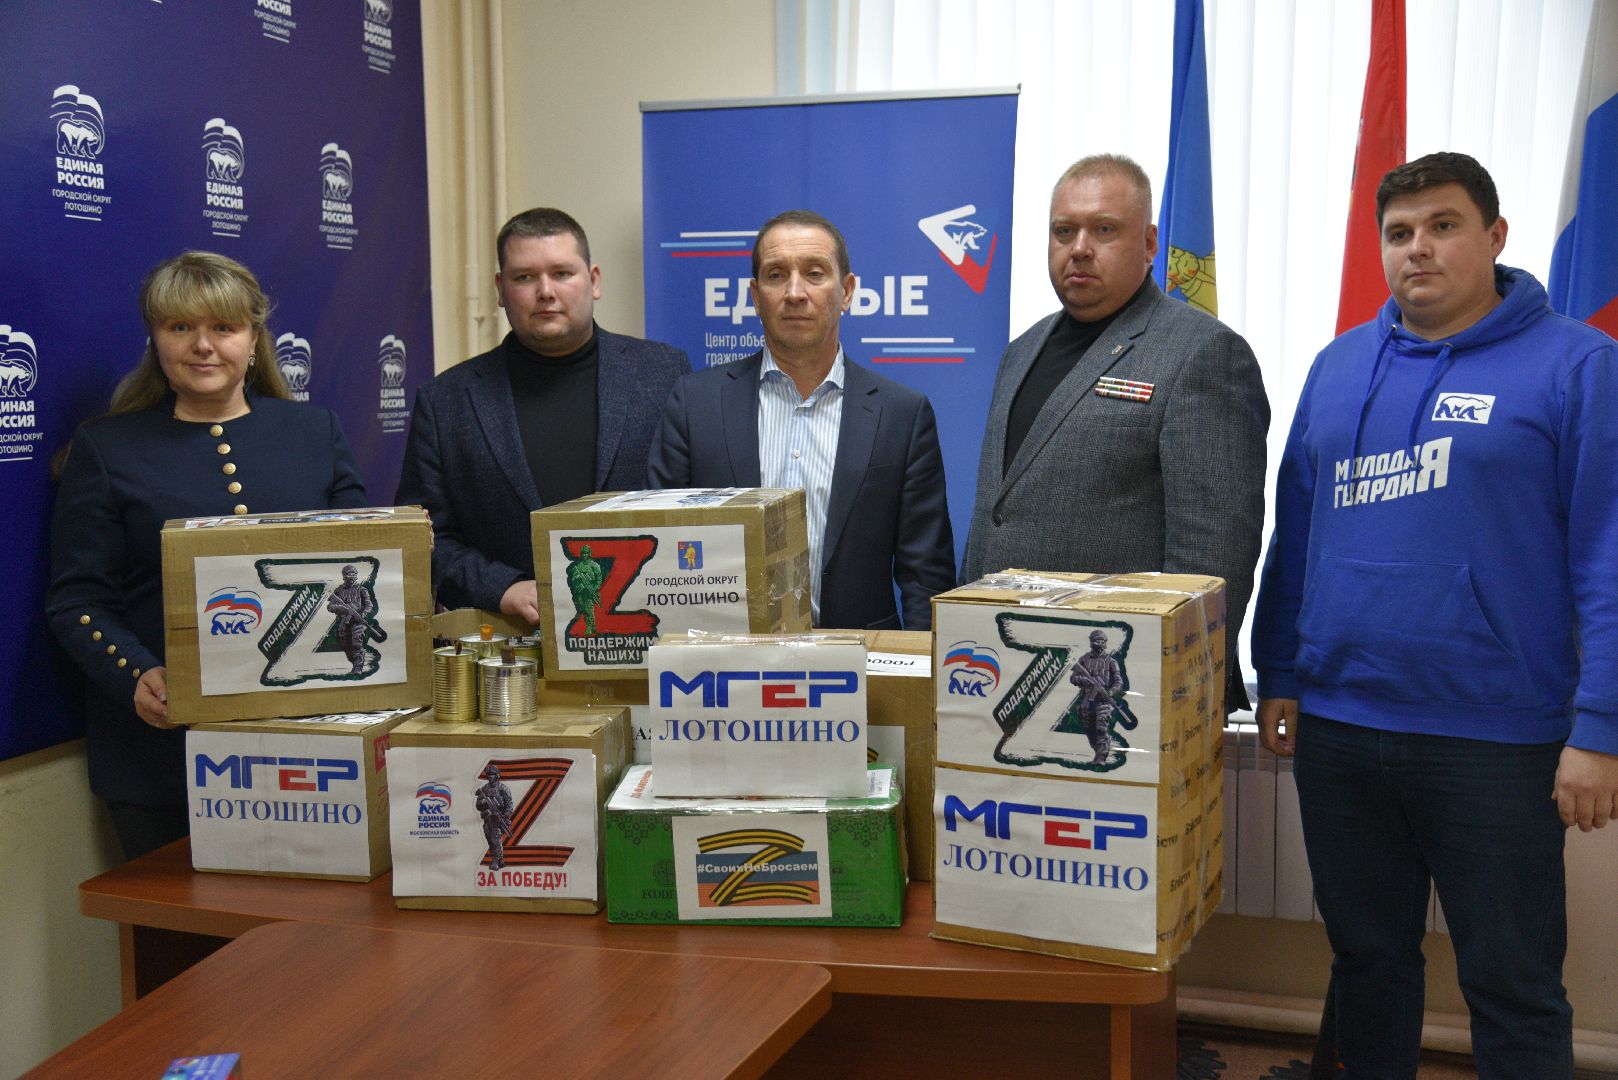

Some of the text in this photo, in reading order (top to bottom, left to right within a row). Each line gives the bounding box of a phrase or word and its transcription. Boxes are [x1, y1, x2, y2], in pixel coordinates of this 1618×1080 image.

[56, 157, 103, 175] ЕДИНАЯ
[57, 171, 104, 189] РОССИЯ
[52, 189, 112, 204] ГОРОДСКОЙ ОКРУГ
[206, 182, 243, 197] ЕДИНАЯ
[64, 202, 102, 214] ЛОТОШИНО
[206, 194, 244, 210] РОССИЯ
[322, 200, 352, 213] ЕДИНАЯ
[322, 211, 353, 225] РОССИЯ
[704, 276, 928, 324] ЕДЫЕ
[705, 332, 737, 348] Центр
[0, 400, 35, 414] ИНАЯ
[23, 432, 43, 441] ОКРУГ
[645, 575, 739, 587] ГОРОДСКОЙ ОКРУГ
[646, 591, 740, 606] ЛОТОШИНО
[262, 585, 311, 652] ПОДДЕРЖИМ
[288, 591, 320, 636] НАШИХ!
[568, 635, 656, 650] ПОДДЕРЖИМ
[587, 650, 641, 661] НАШИХ!
[659, 671, 859, 708] МГЕР
[997, 649, 1053, 723] ПОДДЕРЖИМ
[1027, 657, 1061, 706] НАШИХ!
[659, 719, 860, 743] ЛОТОШИНО
[195, 753, 359, 792] МГЕР
[195, 797, 362, 825] ЛОТОШИНО
[943, 794, 1148, 851] МГЕР
[697, 863, 818, 874] #СвоихНеБросаем
[943, 843, 1149, 891] ЛОТОШИНО
[477, 871, 568, 891] ЗА ПОБЕДУ!
